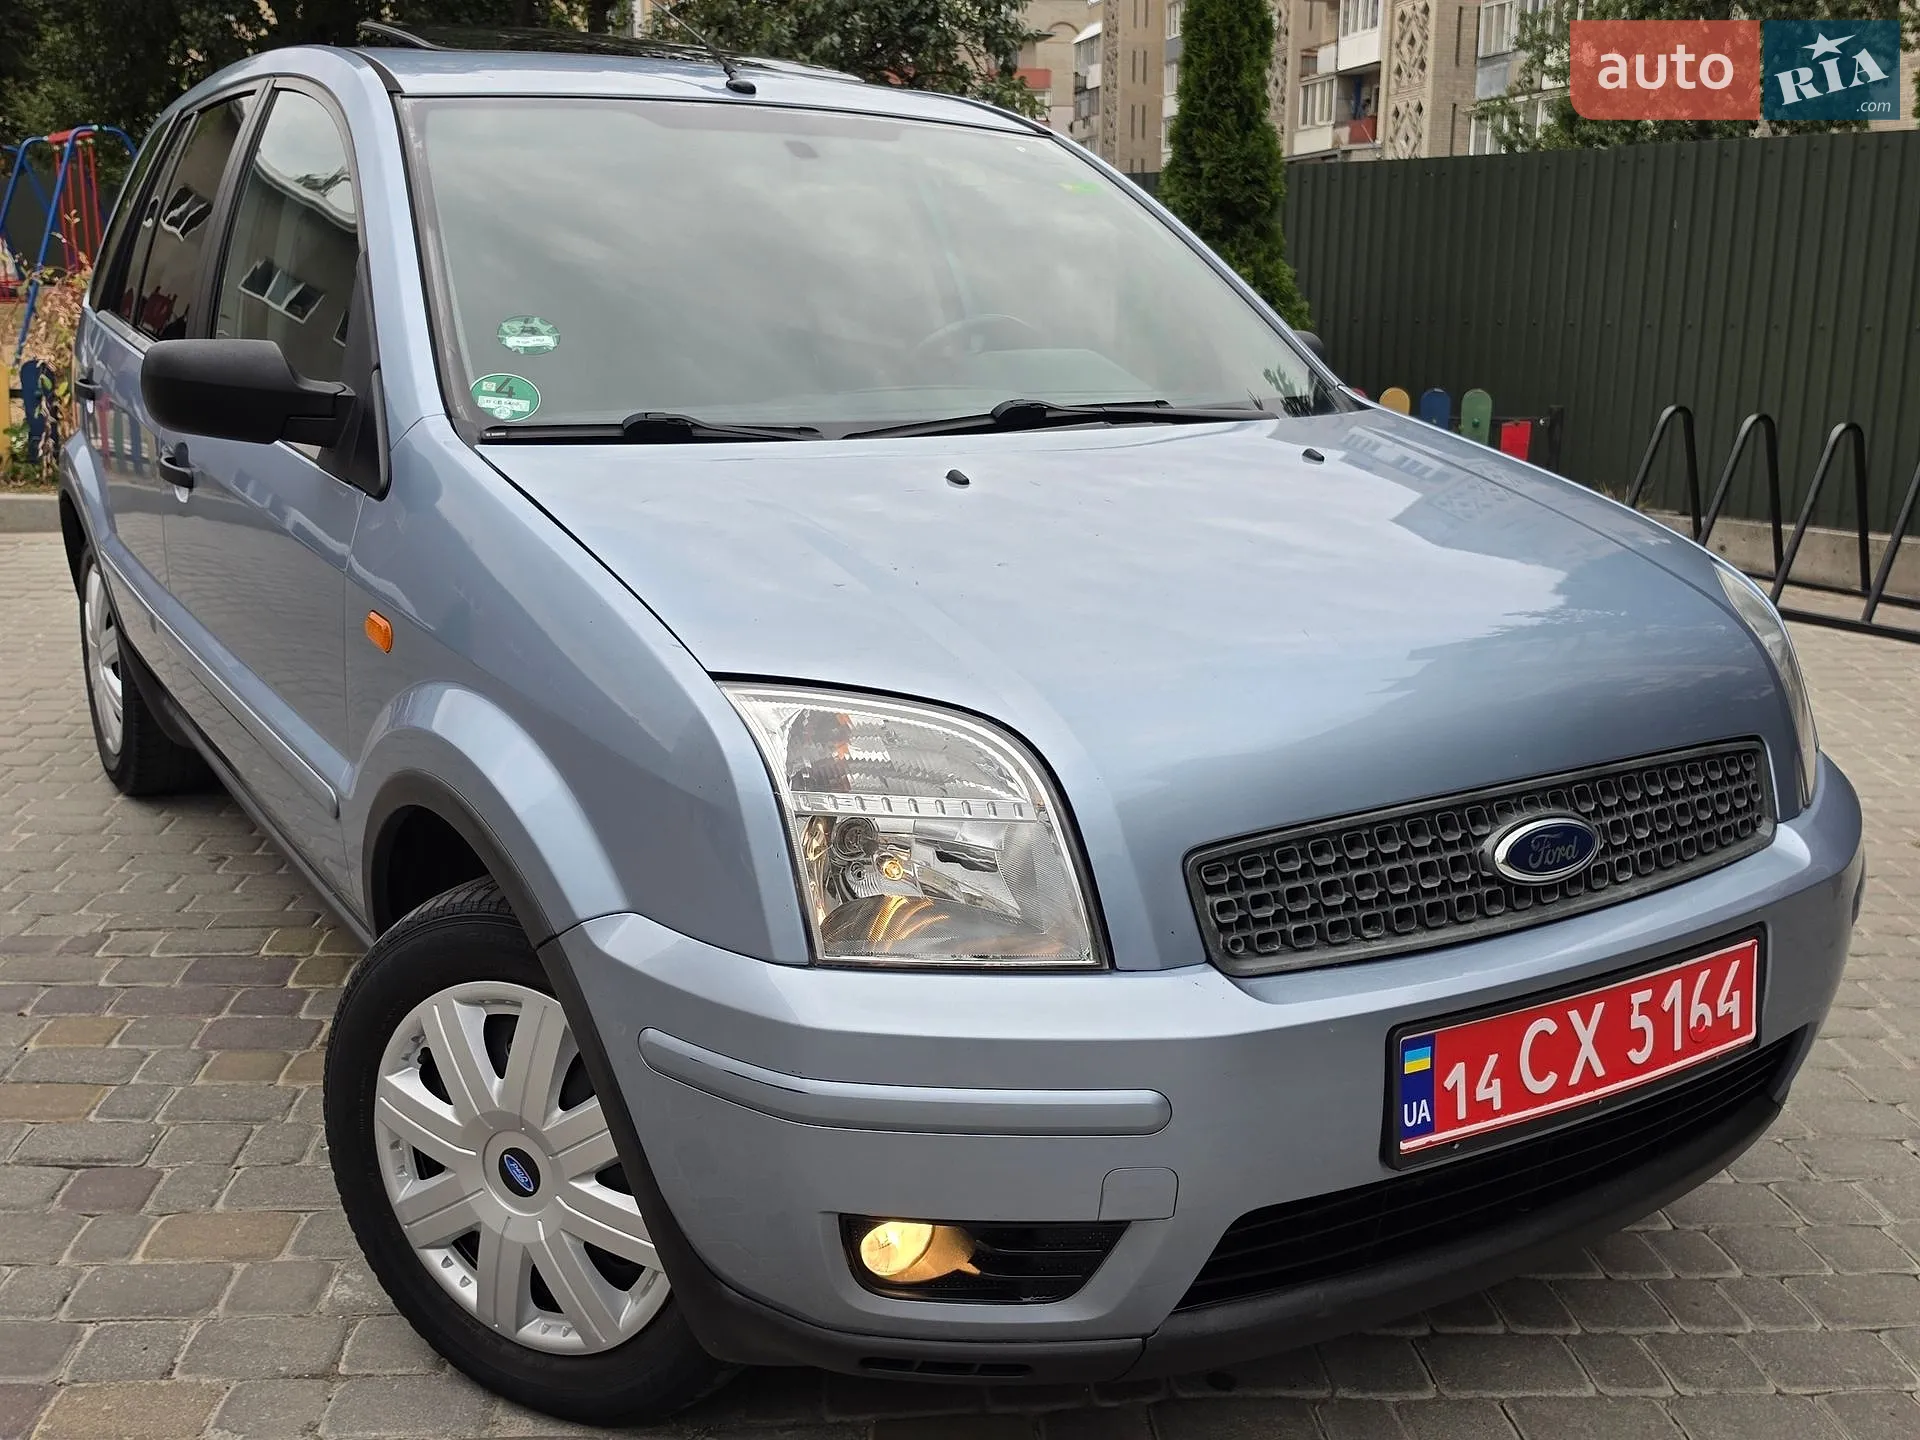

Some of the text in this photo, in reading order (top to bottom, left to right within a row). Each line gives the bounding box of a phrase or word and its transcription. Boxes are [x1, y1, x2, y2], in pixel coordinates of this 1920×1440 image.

[496, 377, 516, 398] 4
[1528, 831, 1578, 869] Ford
[1443, 959, 1741, 1120] 14 CX 5164
[1404, 1098, 1431, 1128] UA
